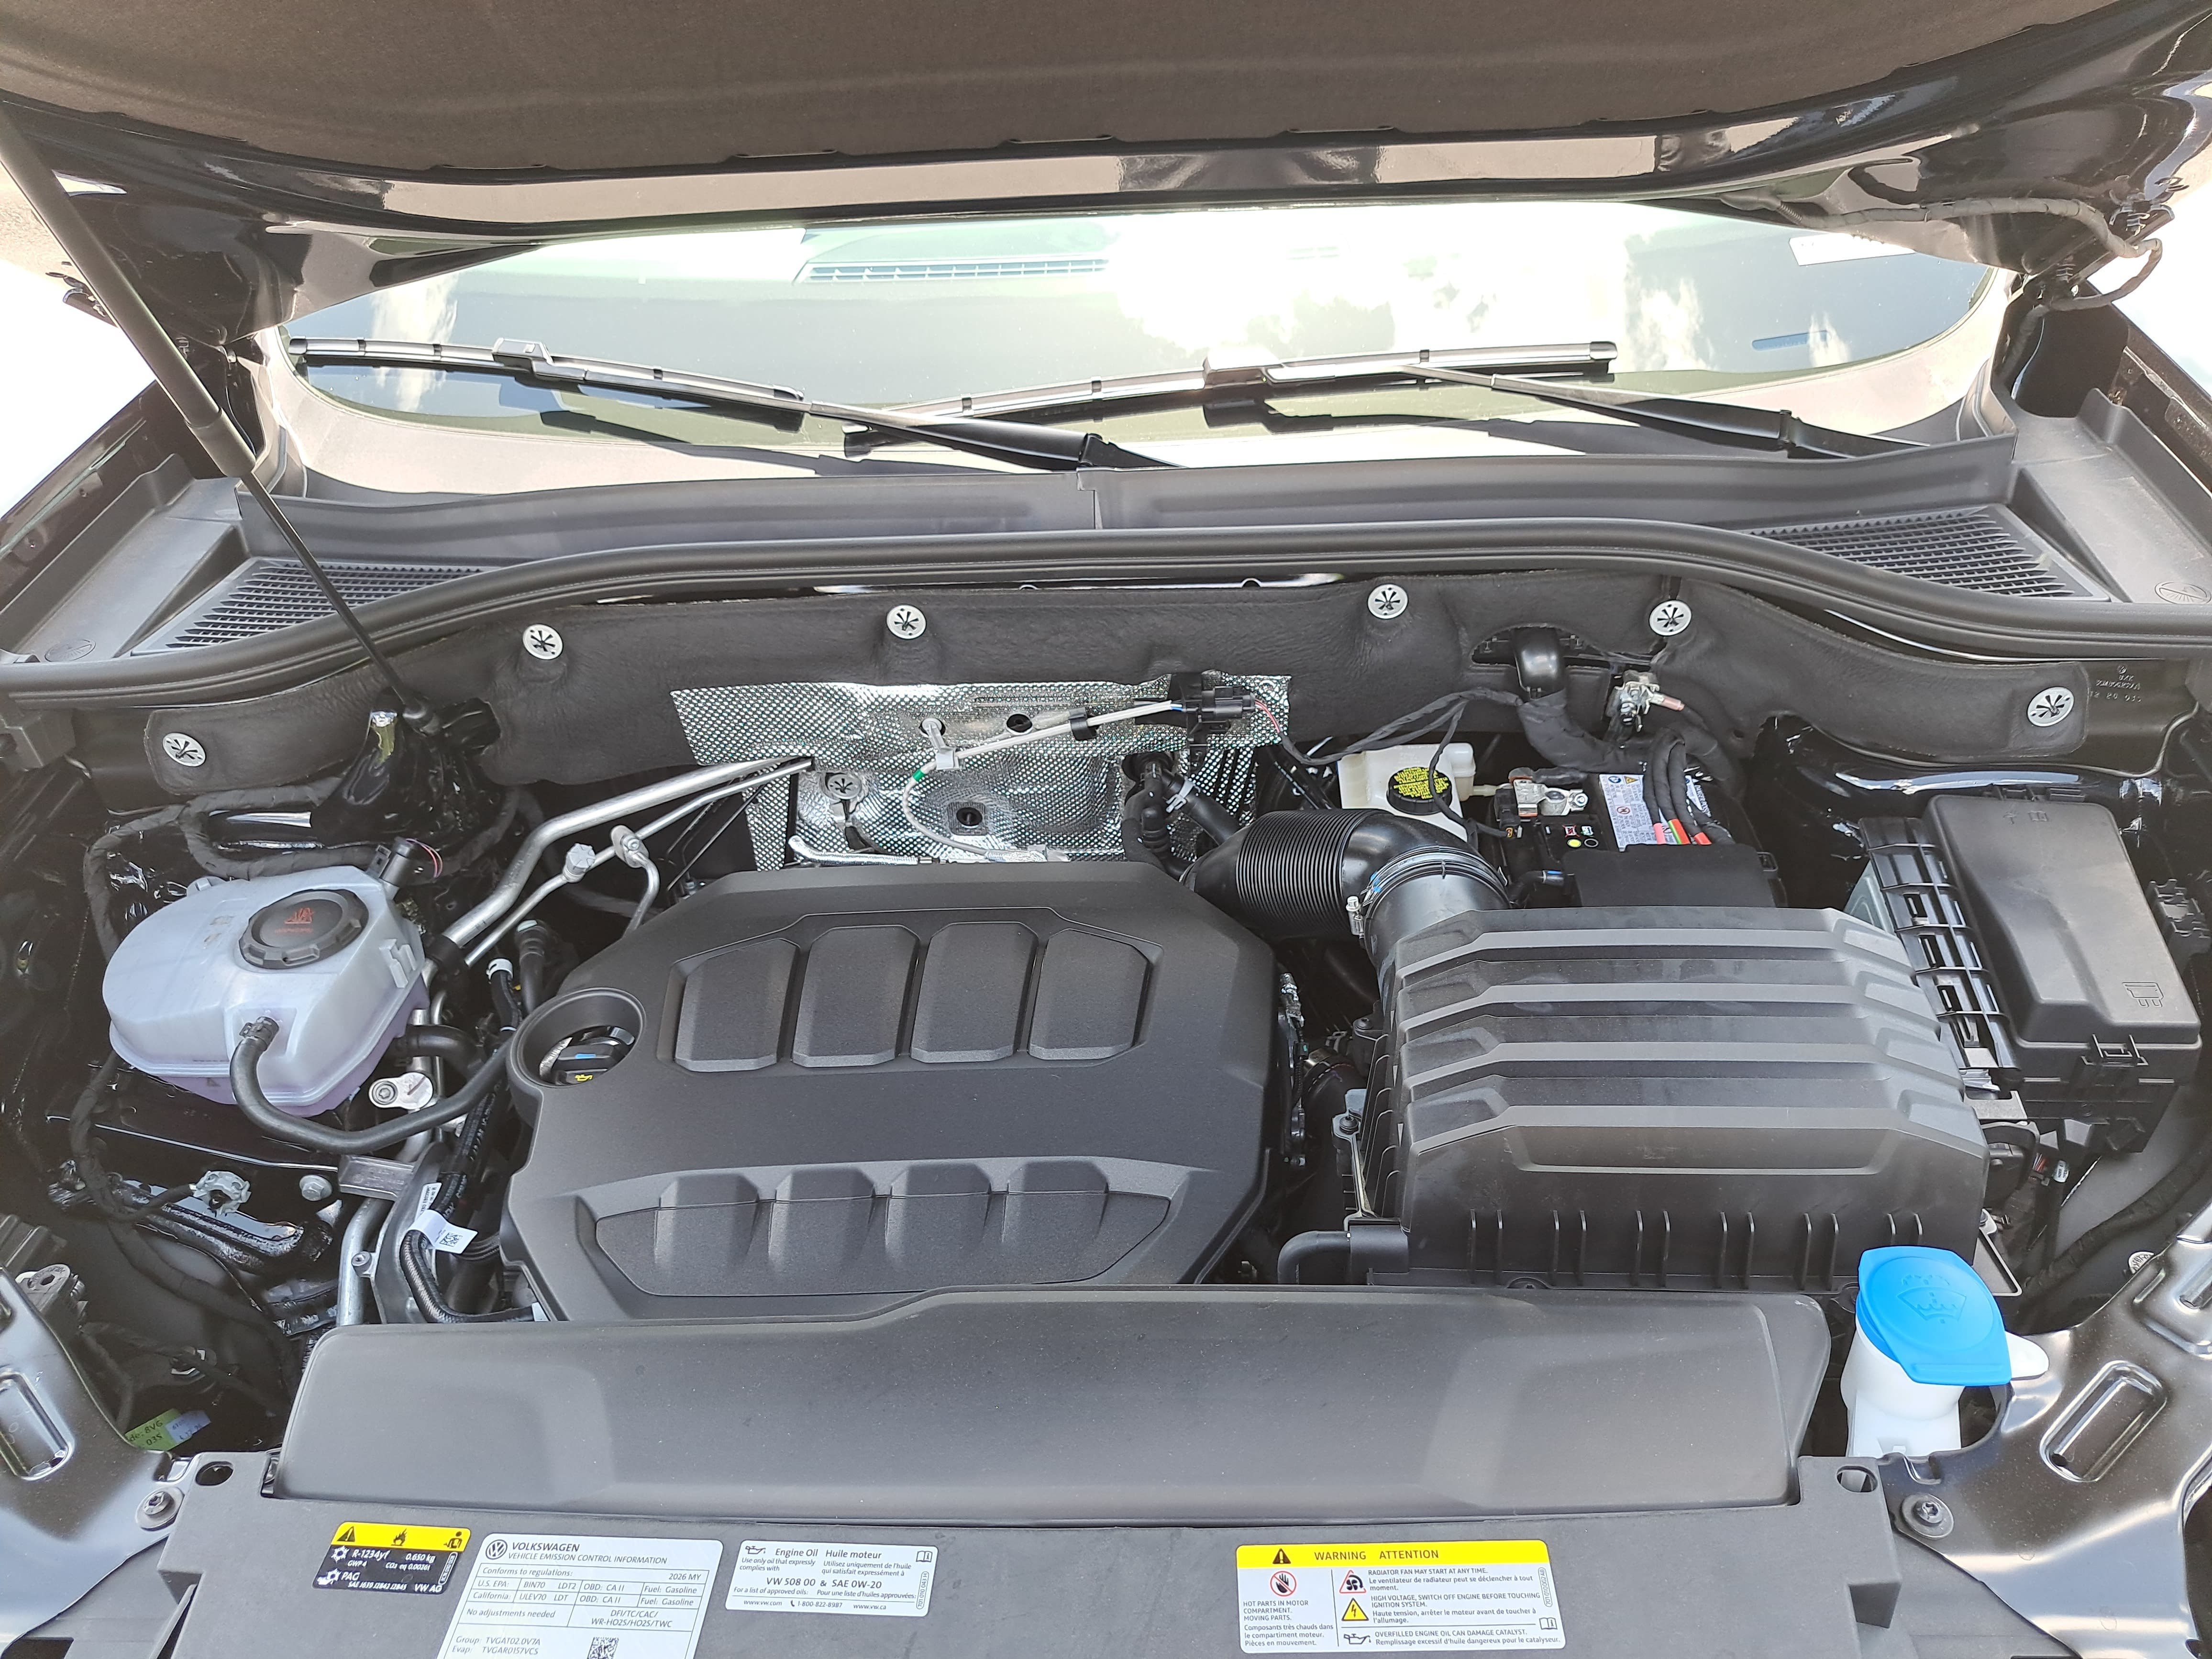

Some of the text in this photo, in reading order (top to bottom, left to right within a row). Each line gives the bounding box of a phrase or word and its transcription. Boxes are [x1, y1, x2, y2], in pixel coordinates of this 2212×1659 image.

[513, 1542, 580, 1552] VOLKSWAGEN
[352, 1549, 390, 1561] R-1234yf
[426, 1554, 435, 1563] kg
[775, 1548, 804, 1558] Engine
[1315, 1550, 1438, 1560] WARNING ATTENTION
[341, 1572, 360, 1581] PAG
[529, 1569, 572, 1577] regulations:
[430, 1584, 442, 1593] AG
[479, 1609, 525, 1617] adjustments
[610, 1610, 658, 1618] DFI/TC/CAC/
[592, 1618, 672, 1627] WR-HO2S/HO2S/TWC
[456, 1636, 481, 1645] Group:
[453, 1646, 472, 1654] Evap:
